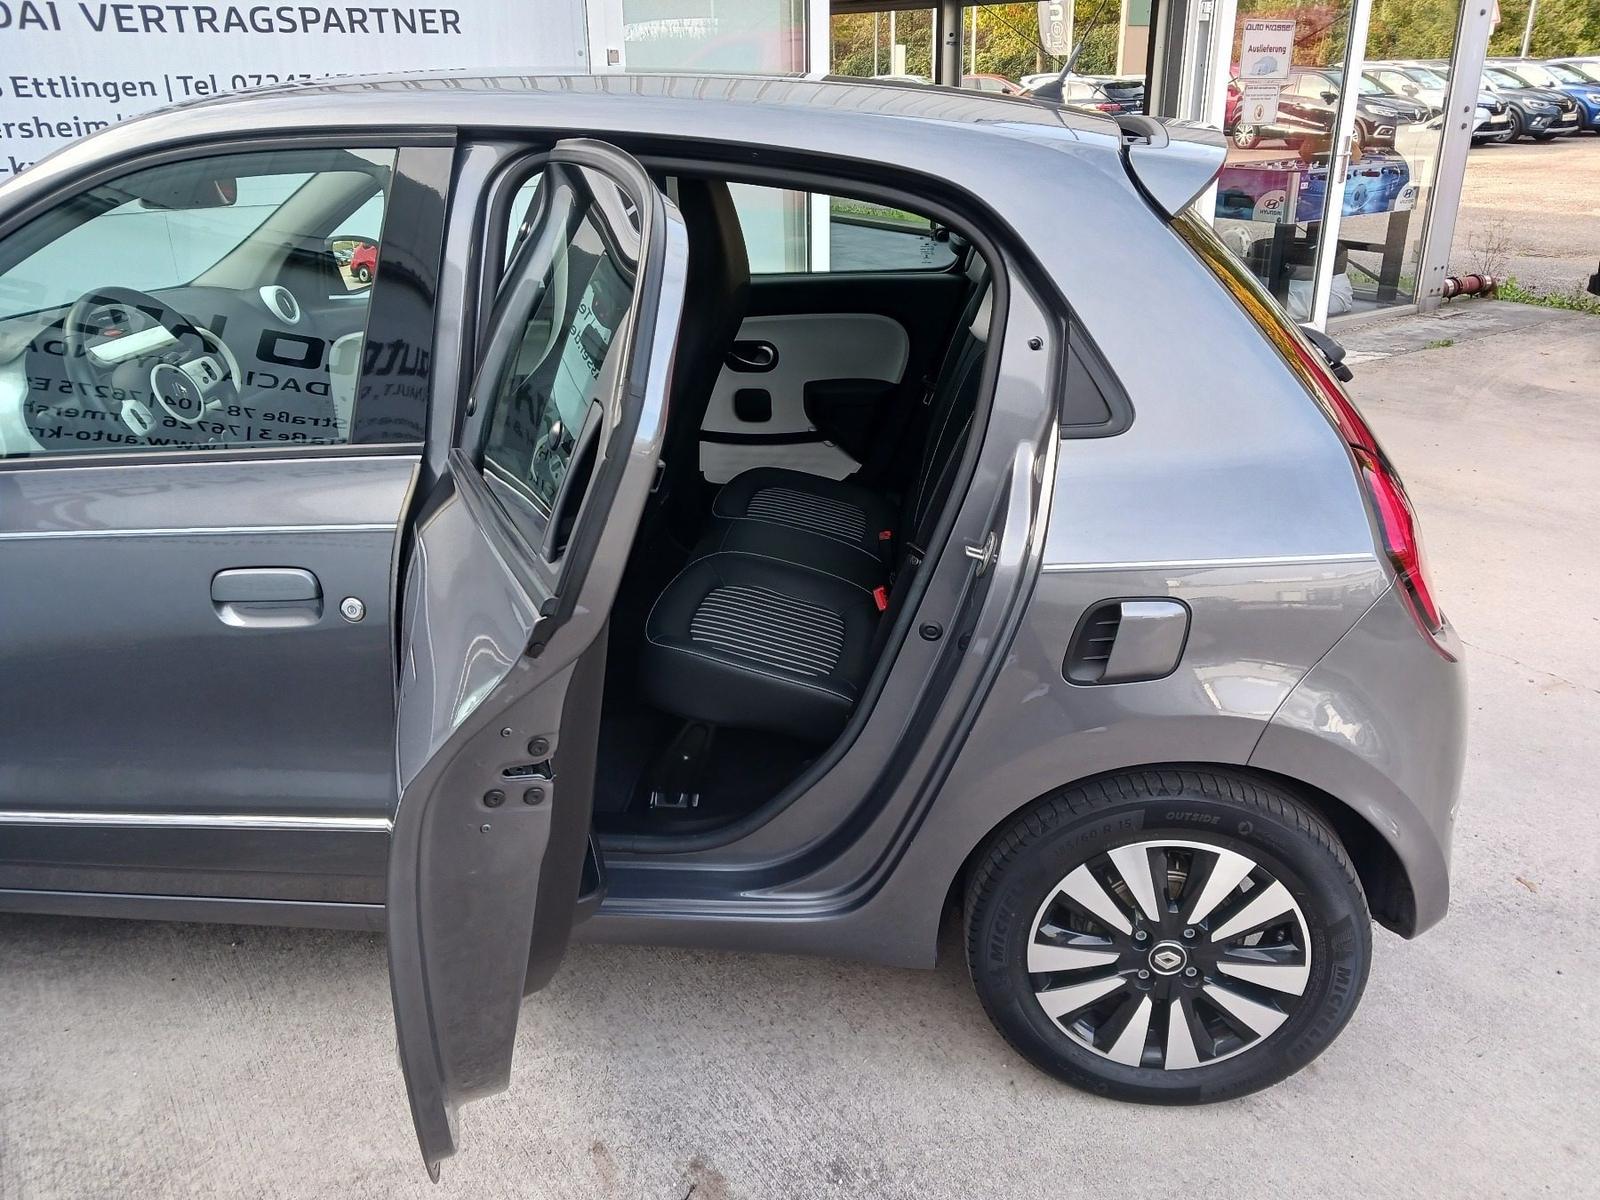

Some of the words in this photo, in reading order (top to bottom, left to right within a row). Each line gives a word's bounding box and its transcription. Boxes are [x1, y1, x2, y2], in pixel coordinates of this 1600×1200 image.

[78, 2, 462, 35] VERTRAGSPARTNER
[1247, 43, 1287, 54] Auslieferung
[9, 75, 158, 103] Ettlingen
[0, 115, 109, 138] rsheim
[1165, 811, 1221, 825] OUTSIDE
